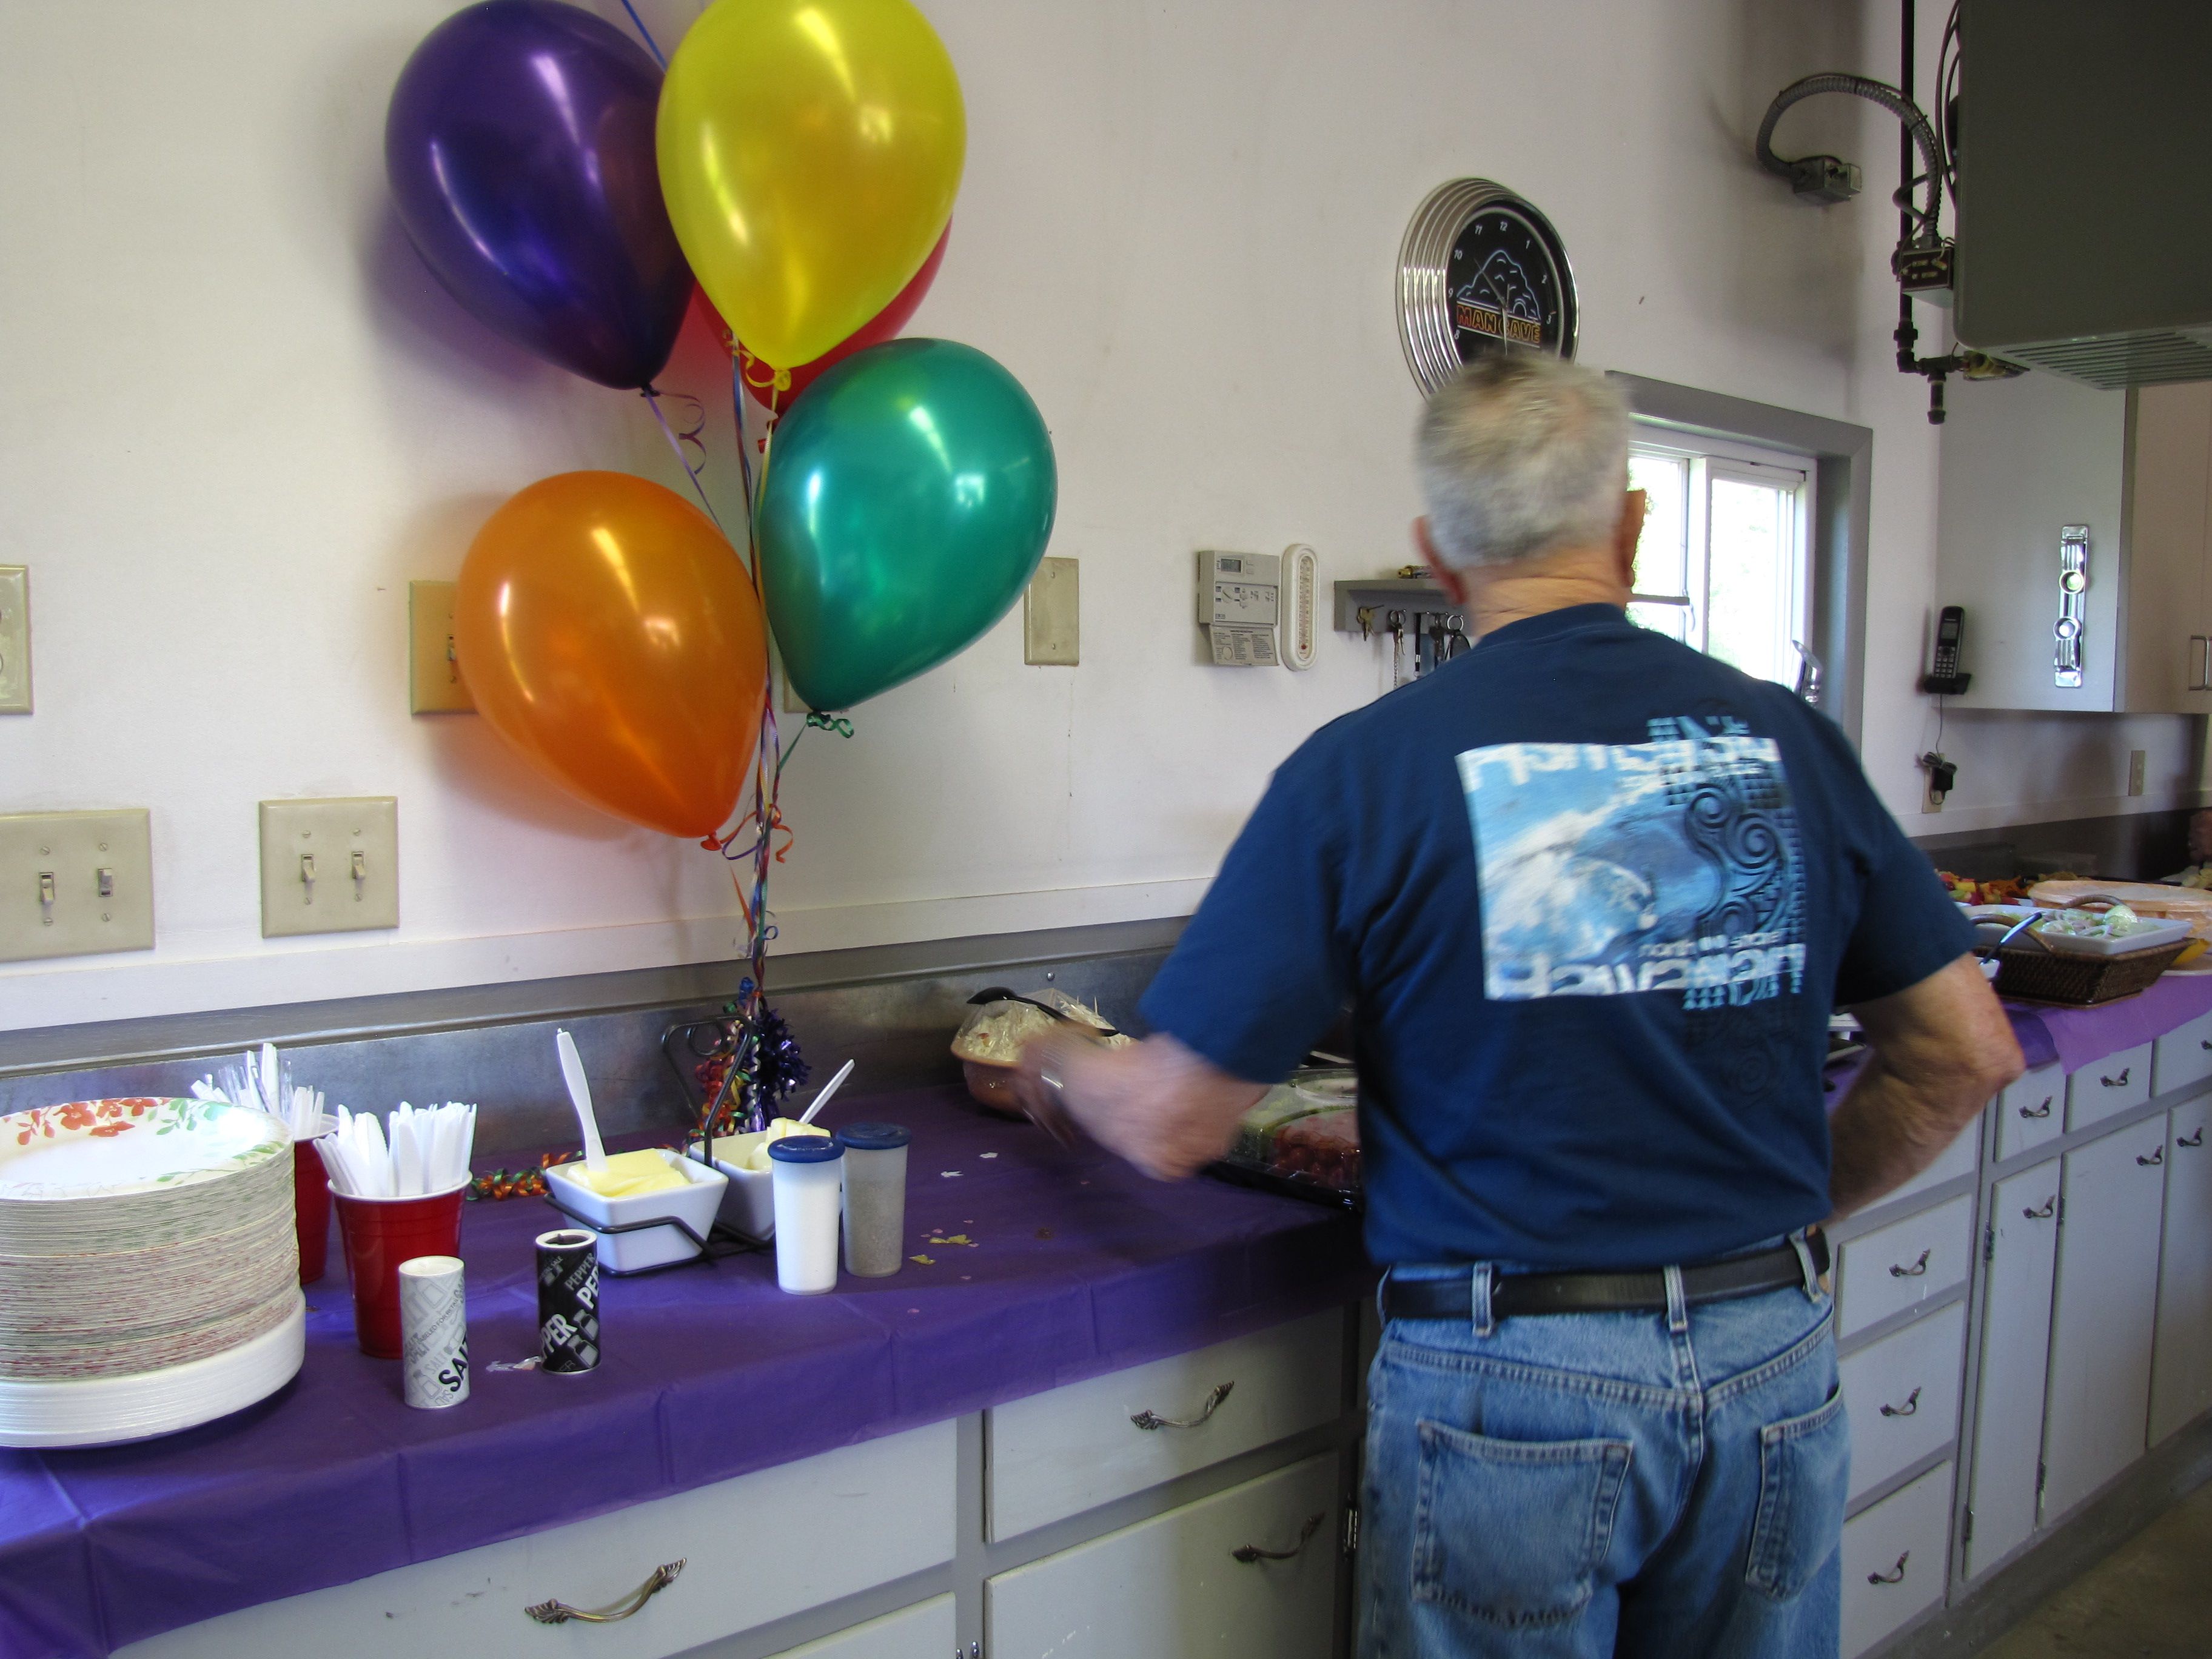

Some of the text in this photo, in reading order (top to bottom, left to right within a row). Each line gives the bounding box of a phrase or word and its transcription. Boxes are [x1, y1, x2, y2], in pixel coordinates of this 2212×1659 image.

[1475, 225, 1483, 235] 11
[1500, 221, 1508, 232] 12
[1526, 240, 1530, 249] 1
[1454, 250, 1463, 260] 10
[1541, 275, 1547, 284] 2
[1449, 288, 1453, 298] 9
[1456, 305, 1497, 334] MAN
[1547, 315, 1552, 324] 3
[1454, 330, 1460, 340] 8
[564, 1252, 595, 1291] PEPPER
